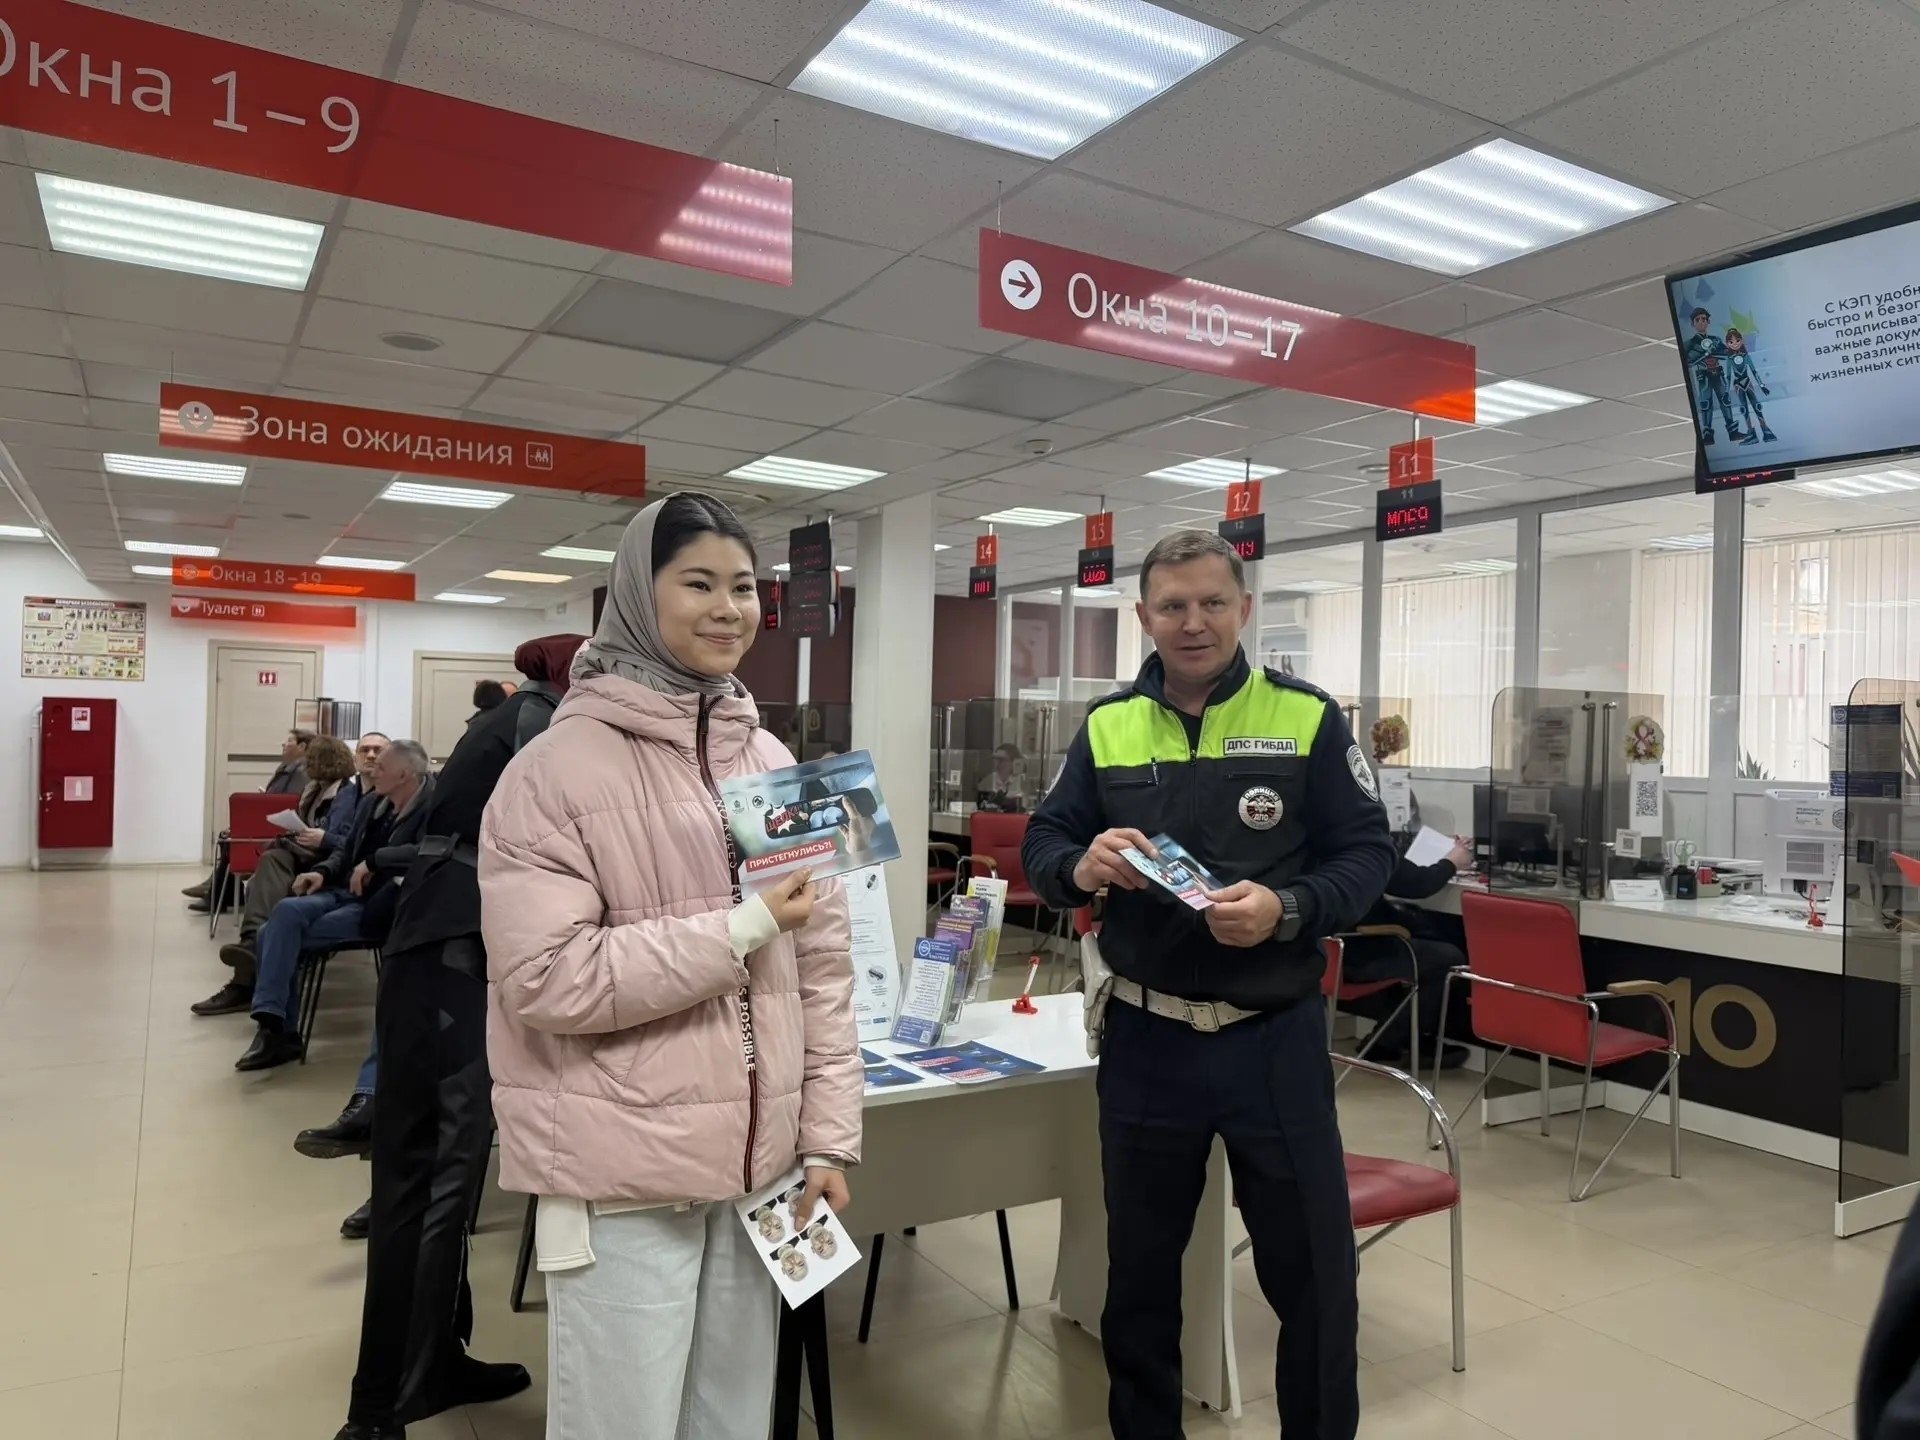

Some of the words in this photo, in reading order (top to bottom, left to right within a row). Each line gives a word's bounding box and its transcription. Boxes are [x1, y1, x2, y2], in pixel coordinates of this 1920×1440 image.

[0, 17, 171, 116] кна
[1824, 302, 1835, 313] С
[1838, 294, 1871, 311] КЭП
[1067, 272, 1168, 335] Окна
[1184, 298, 1301, 361] 10–17
[1807, 313, 1861, 331] быстро
[1864, 310, 1873, 319] и
[1815, 337, 1872, 356] важные
[1841, 355, 1850, 364] в
[1810, 360, 1893, 382] жизненных
[239, 406, 328, 445] Зона
[342, 426, 513, 466] ожидания
[1398, 453, 1421, 478] 11
[1233, 491, 1251, 512] 12
[980, 543, 992, 560] 14
[210, 565, 257, 584] Окна
[202, 601, 246, 617] Туалет
[1227, 740, 1251, 751] ДПС
[1254, 740, 1294, 751] ГИБДД
[1666, 976, 1777, 1068] 10
[739, 1001, 756, 1072] POSSIBLE
